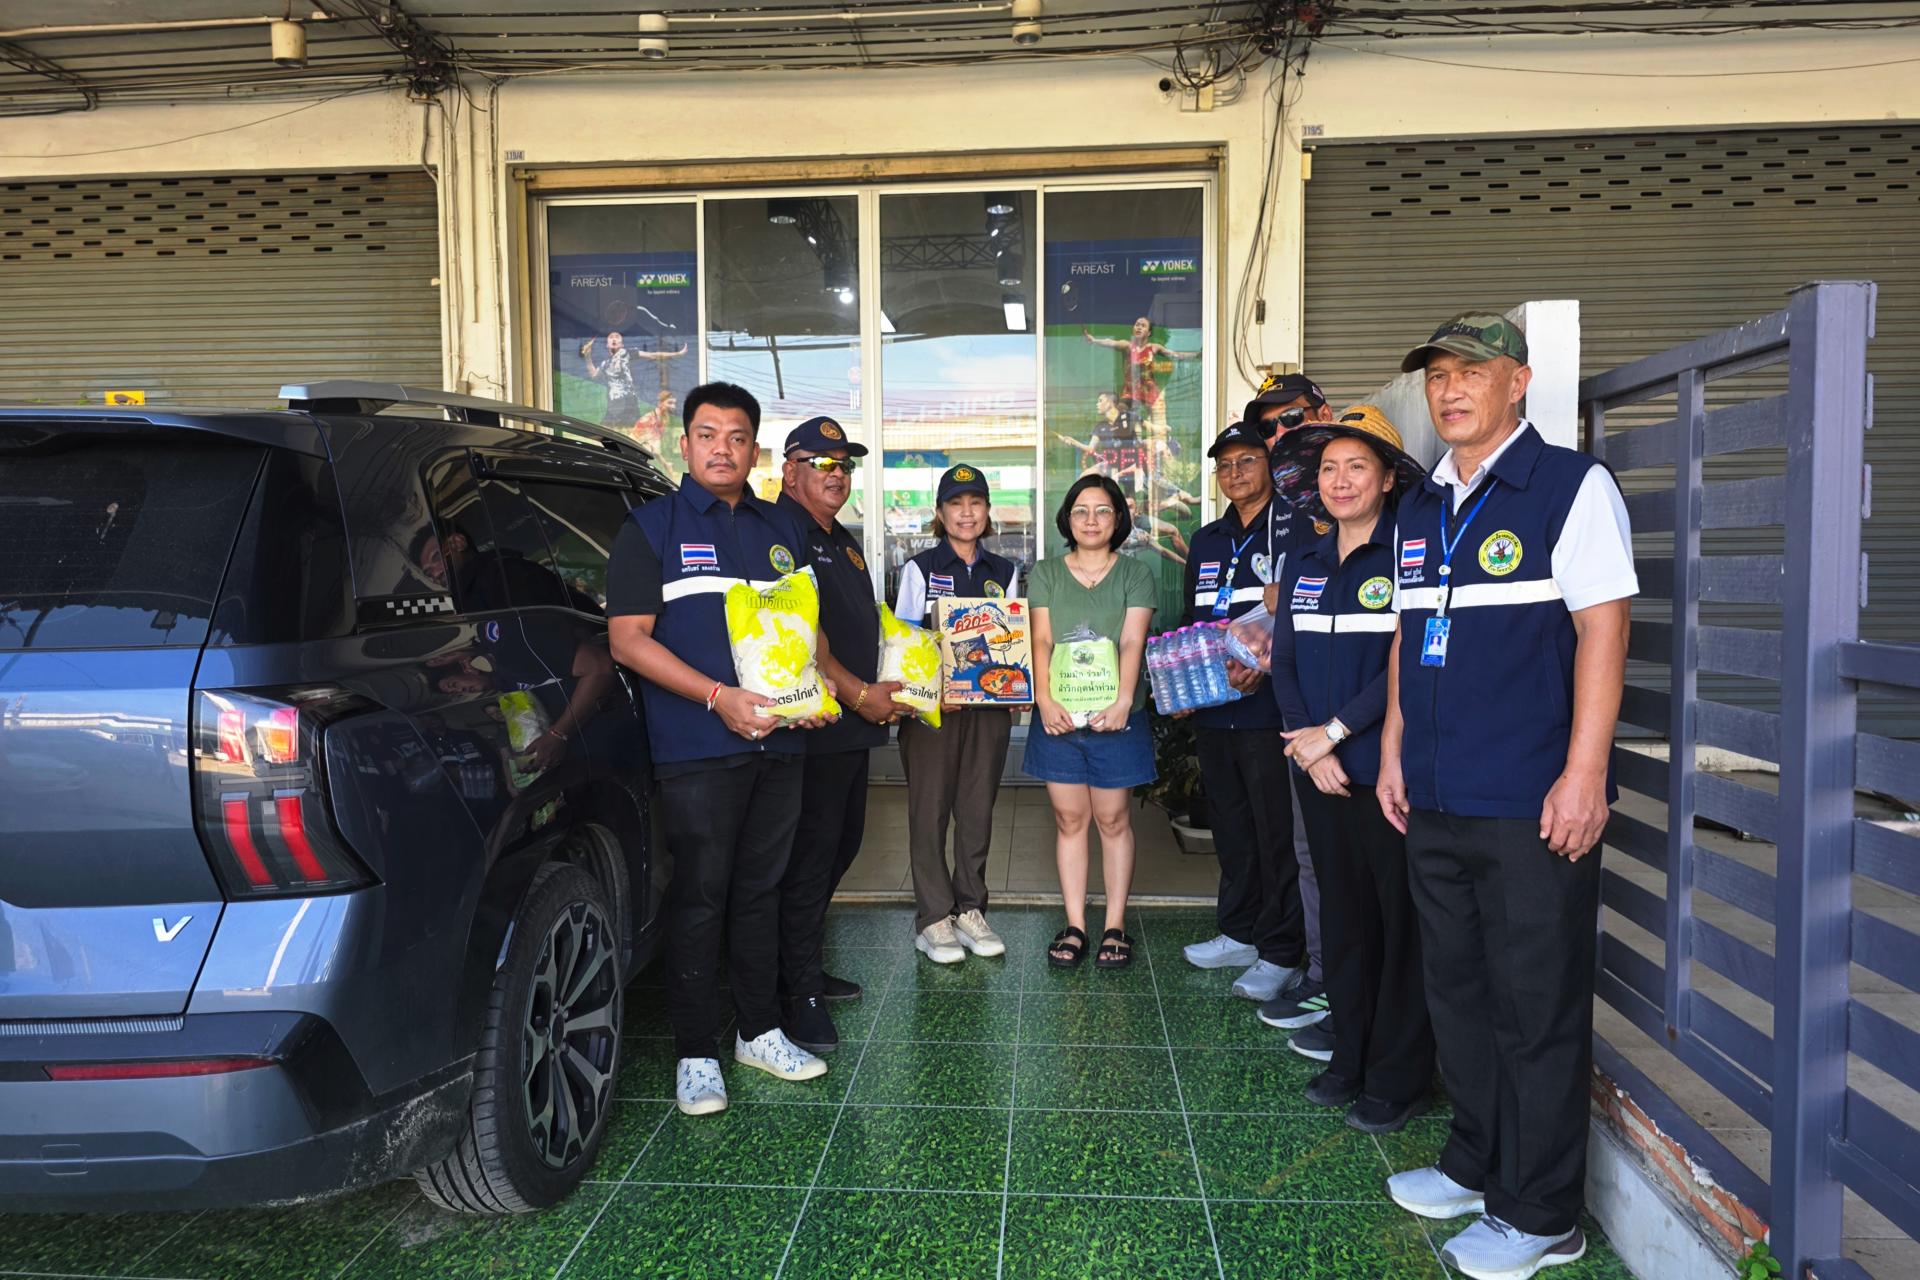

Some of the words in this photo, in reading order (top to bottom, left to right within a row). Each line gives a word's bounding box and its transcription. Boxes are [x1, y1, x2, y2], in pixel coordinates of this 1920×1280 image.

[1071, 264, 1115, 275] FAREAST
[1162, 259, 1193, 271] YONEX
[571, 277, 612, 287] FAREAST
[657, 273, 687, 284] YONEX
